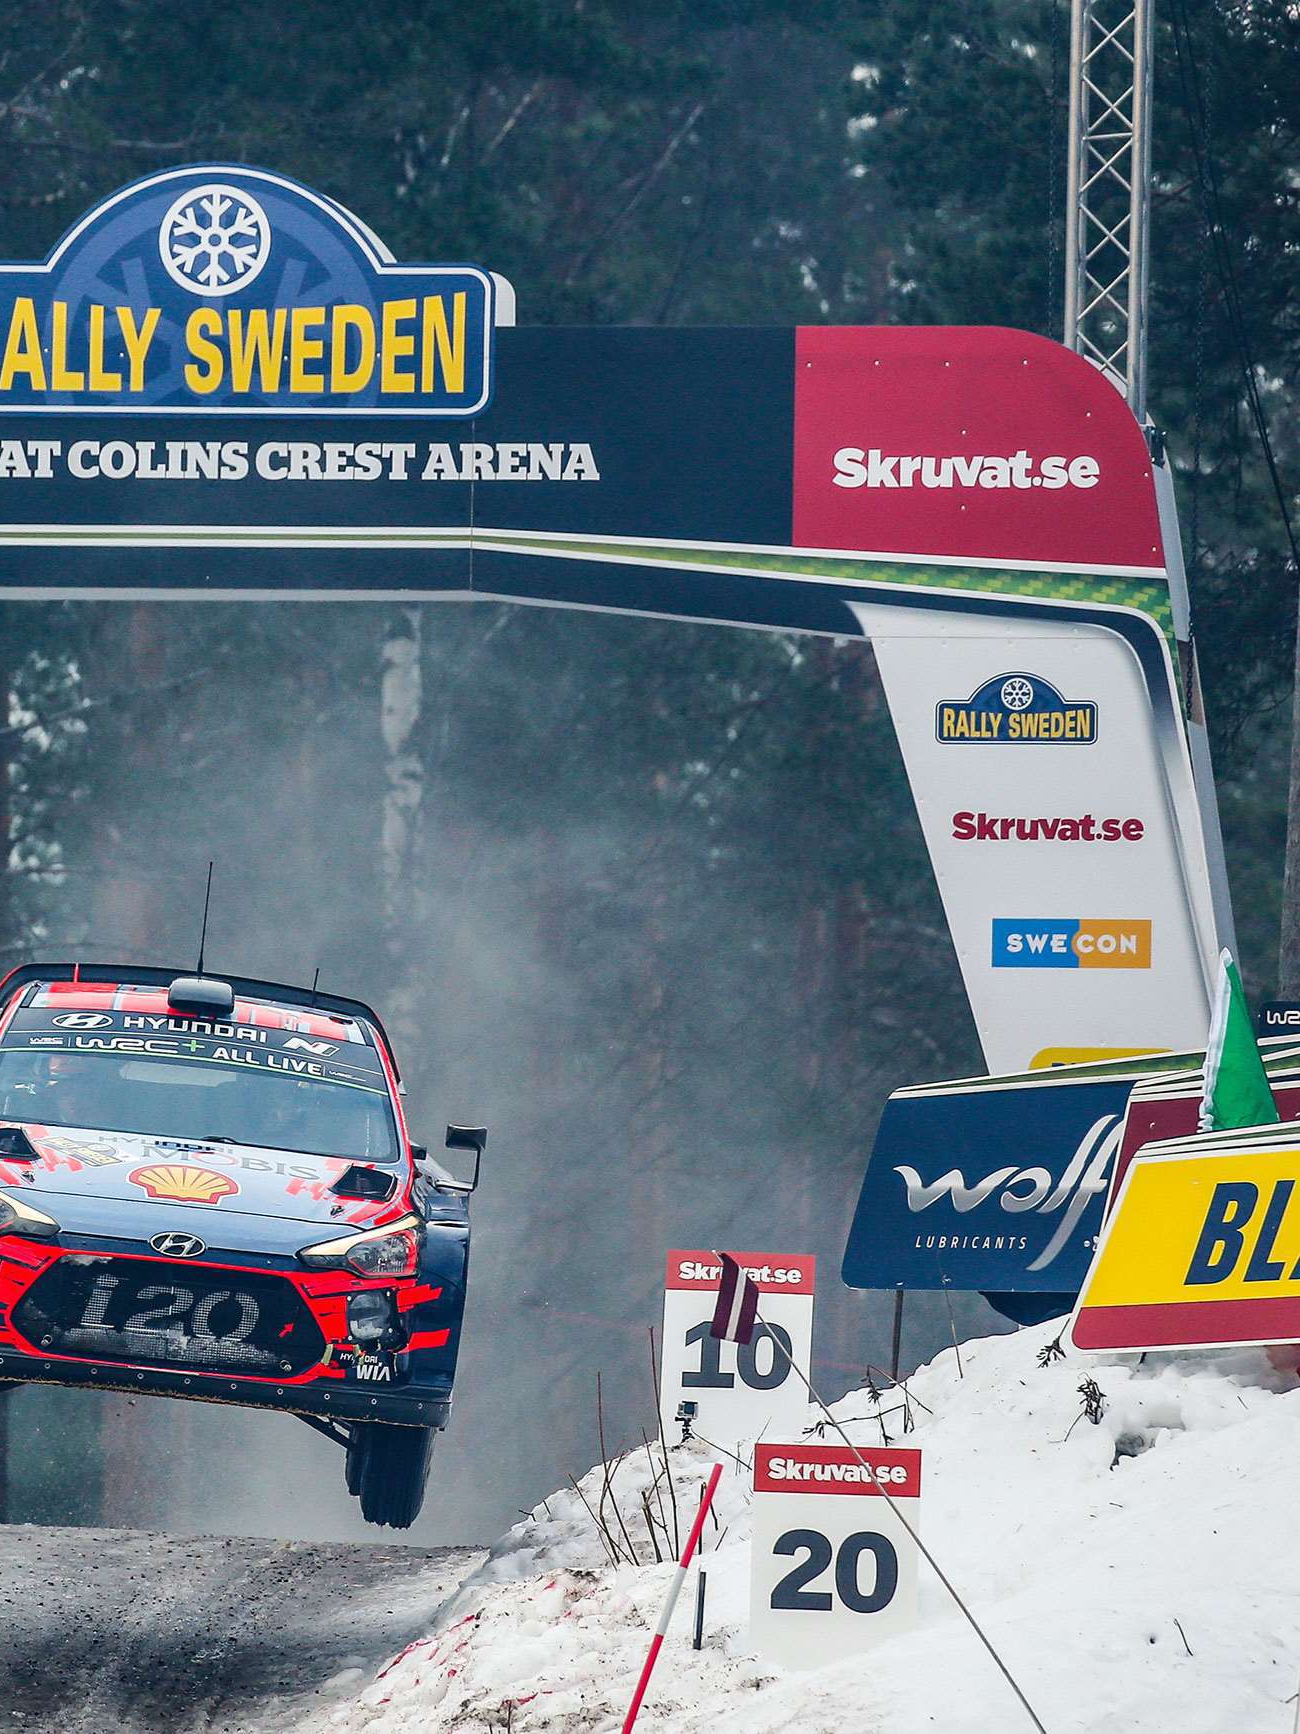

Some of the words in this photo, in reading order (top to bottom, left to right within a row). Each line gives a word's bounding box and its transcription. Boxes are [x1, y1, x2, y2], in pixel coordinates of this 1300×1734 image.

[183, 291, 468, 395] SWEDEN
[67, 440, 250, 482] COLINS
[255, 441, 417, 482] CREST
[421, 441, 600, 483] ARENA
[832, 447, 1101, 490] Skruvat.se
[943, 707, 1002, 738] RALLY
[1008, 708, 1091, 739] SWEDEN
[952, 811, 1145, 842] Skruvat.se
[123, 1016, 268, 1043] HYUNDAI
[212, 1046, 260, 1065] ALL
[267, 1054, 323, 1076] LIVE
[142, 1146, 321, 1181] MOBIS
[914, 1235, 1028, 1251] LUBRICANTS
[1183, 1178, 1300, 1286] BL
[679, 1261, 802, 1283] Skrat.se
[681, 1320, 793, 1391] 10
[770, 1528, 899, 1614] 20
